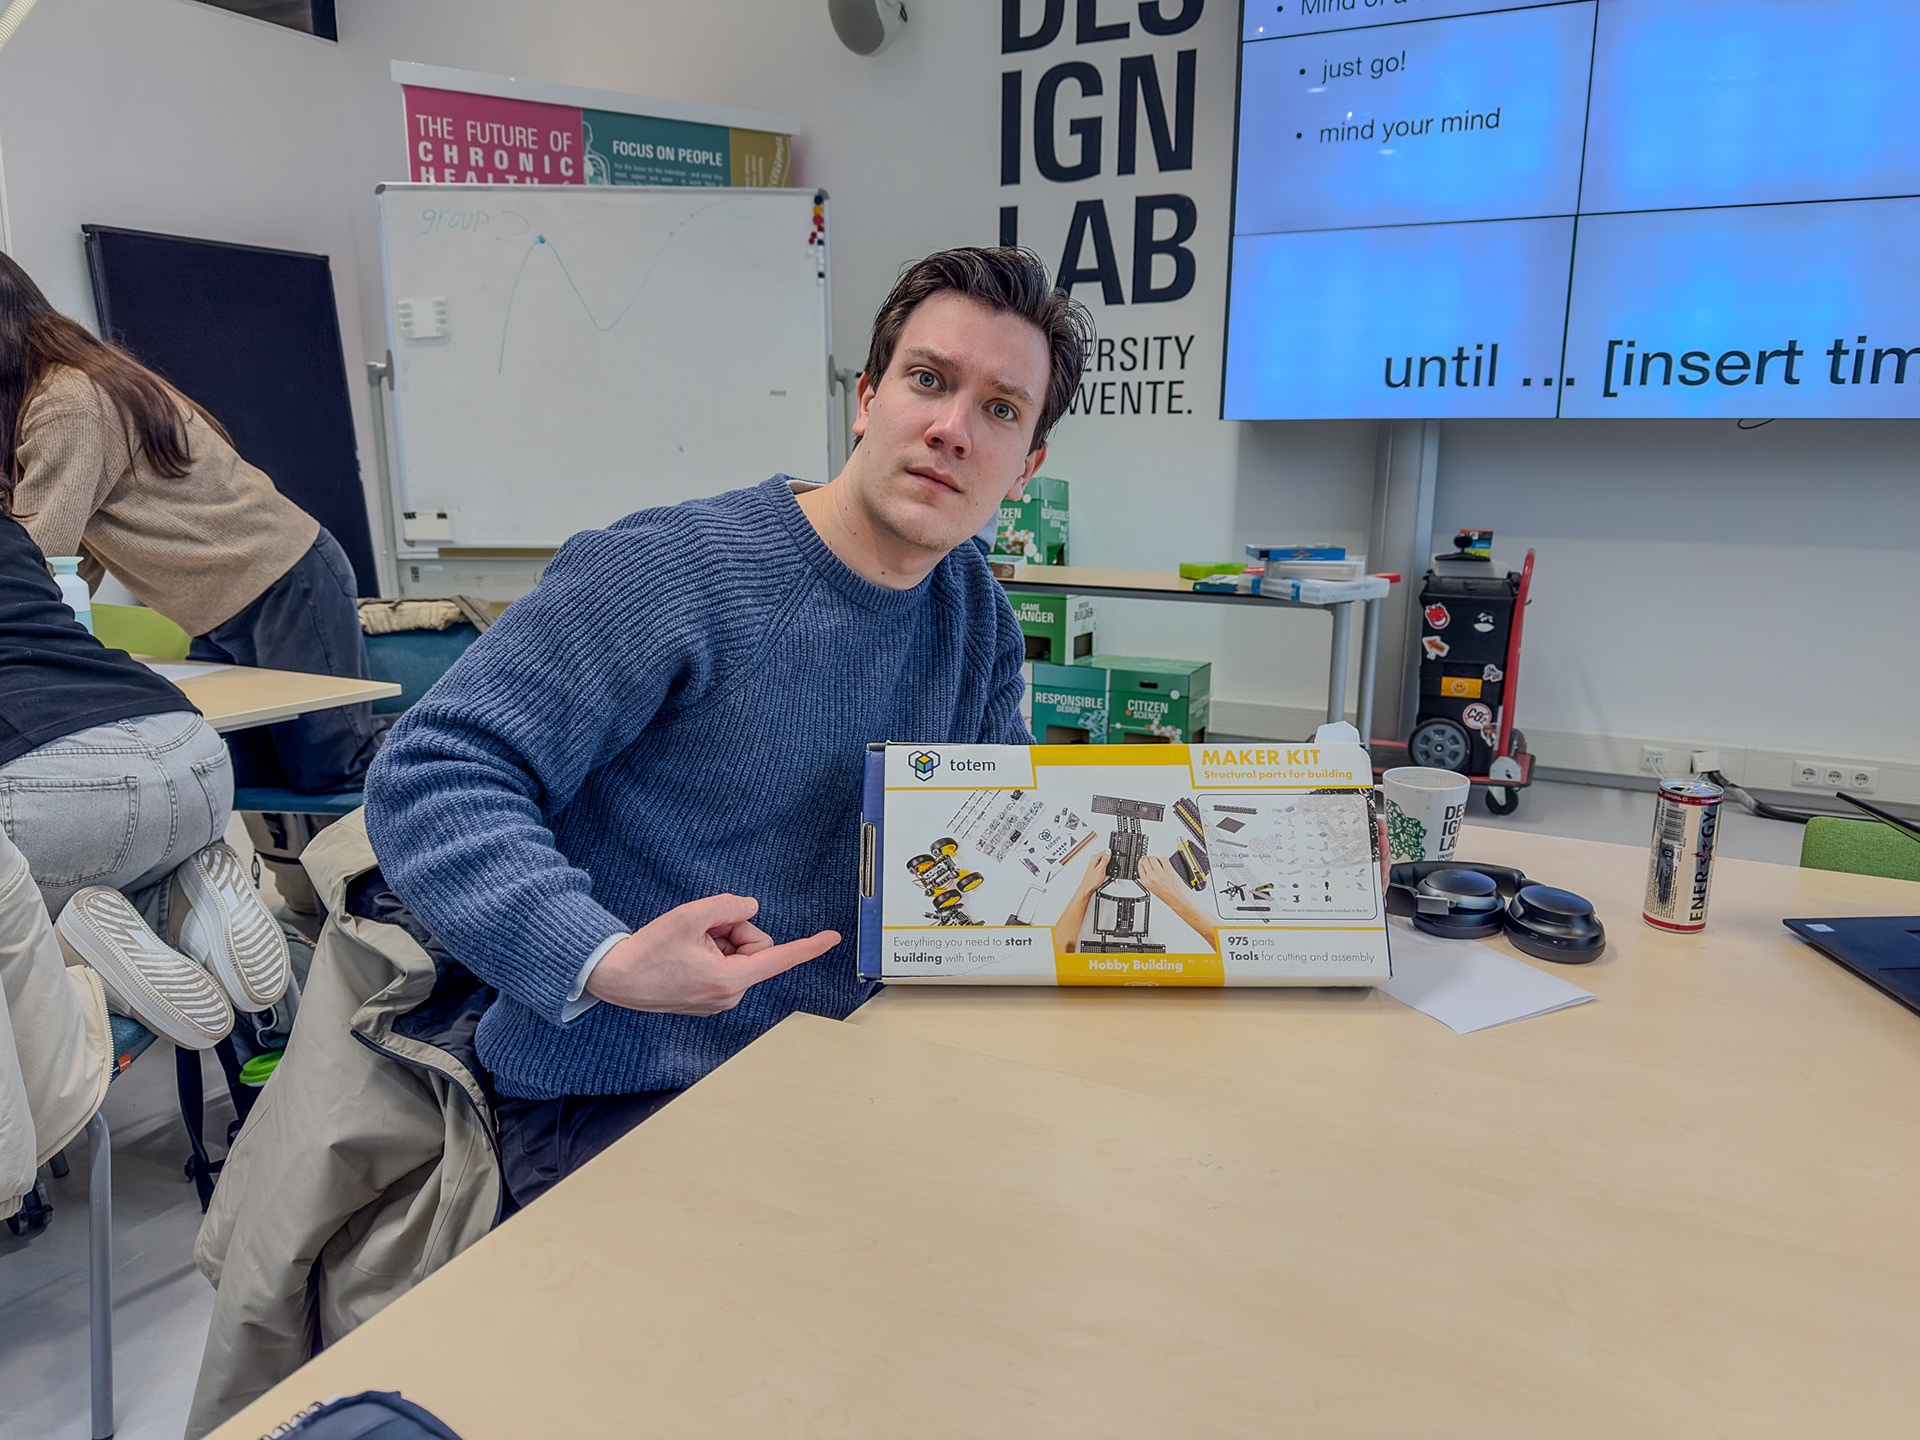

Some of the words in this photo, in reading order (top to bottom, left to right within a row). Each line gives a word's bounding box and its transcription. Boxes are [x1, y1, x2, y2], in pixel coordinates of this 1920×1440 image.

[1321, 55, 1362, 84] just
[1370, 50, 1406, 79] go!
[1000, 48, 1197, 186] IGN
[1320, 119, 1374, 143] mind
[1382, 116, 1434, 143] your
[1440, 107, 1501, 133] mind
[415, 114, 454, 140] THE
[466, 120, 539, 149] FUTURE
[550, 130, 573, 153] OF
[418, 140, 574, 177] CHRONIC
[612, 140, 654, 159] FOCUS
[656, 145, 675, 161] ON
[678, 148, 723, 167] PEOPLE
[420, 208, 490, 235] group
[1081, 334, 1195, 372] ERSITY
[1383, 343, 1499, 389] until
[1602, 338, 1804, 398] [insert
[1069, 380, 1192, 415] WENTE.
[1021, 602, 1040, 611] GAME
[1014, 609, 1055, 624] HANGER
[1035, 692, 1104, 709] RESPONSIBLE
[1127, 699, 1169, 714] CITIZEN
[1056, 705, 1081, 715] DESIGN
[1133, 711, 1162, 721] SCIENCE
[949, 759, 996, 772] totem
[1201, 749, 1281, 766] MAKER
[1287, 749, 1321, 765] KIT
[1204, 769, 1256, 779] Structural
[1259, 770, 1287, 781] parts
[1289, 769, 1305, 778] for
[1308, 769, 1353, 781] building
[1444, 803, 1466, 820] DE
[1439, 834, 1459, 852] LA
[893, 936, 942, 949] Everything
[944, 937, 963, 949] you
[965, 936, 990, 947] need
[992, 938, 1002, 947] to
[1005, 937, 1033, 947] start
[1227, 936, 1249, 946] 975
[1251, 937, 1275, 949] parts
[893, 952, 942, 966] building
[945, 952, 964, 963] with
[967, 952, 996, 963] Totem
[1088, 959, 1130, 973] Hobby
[1133, 959, 1184, 973] Building
[1229, 951, 1259, 961] Tools
[1261, 951, 1274, 961] for
[1277, 951, 1307, 964] cutting
[1309, 951, 1329, 961] and
[1331, 951, 1375, 964] assembly
